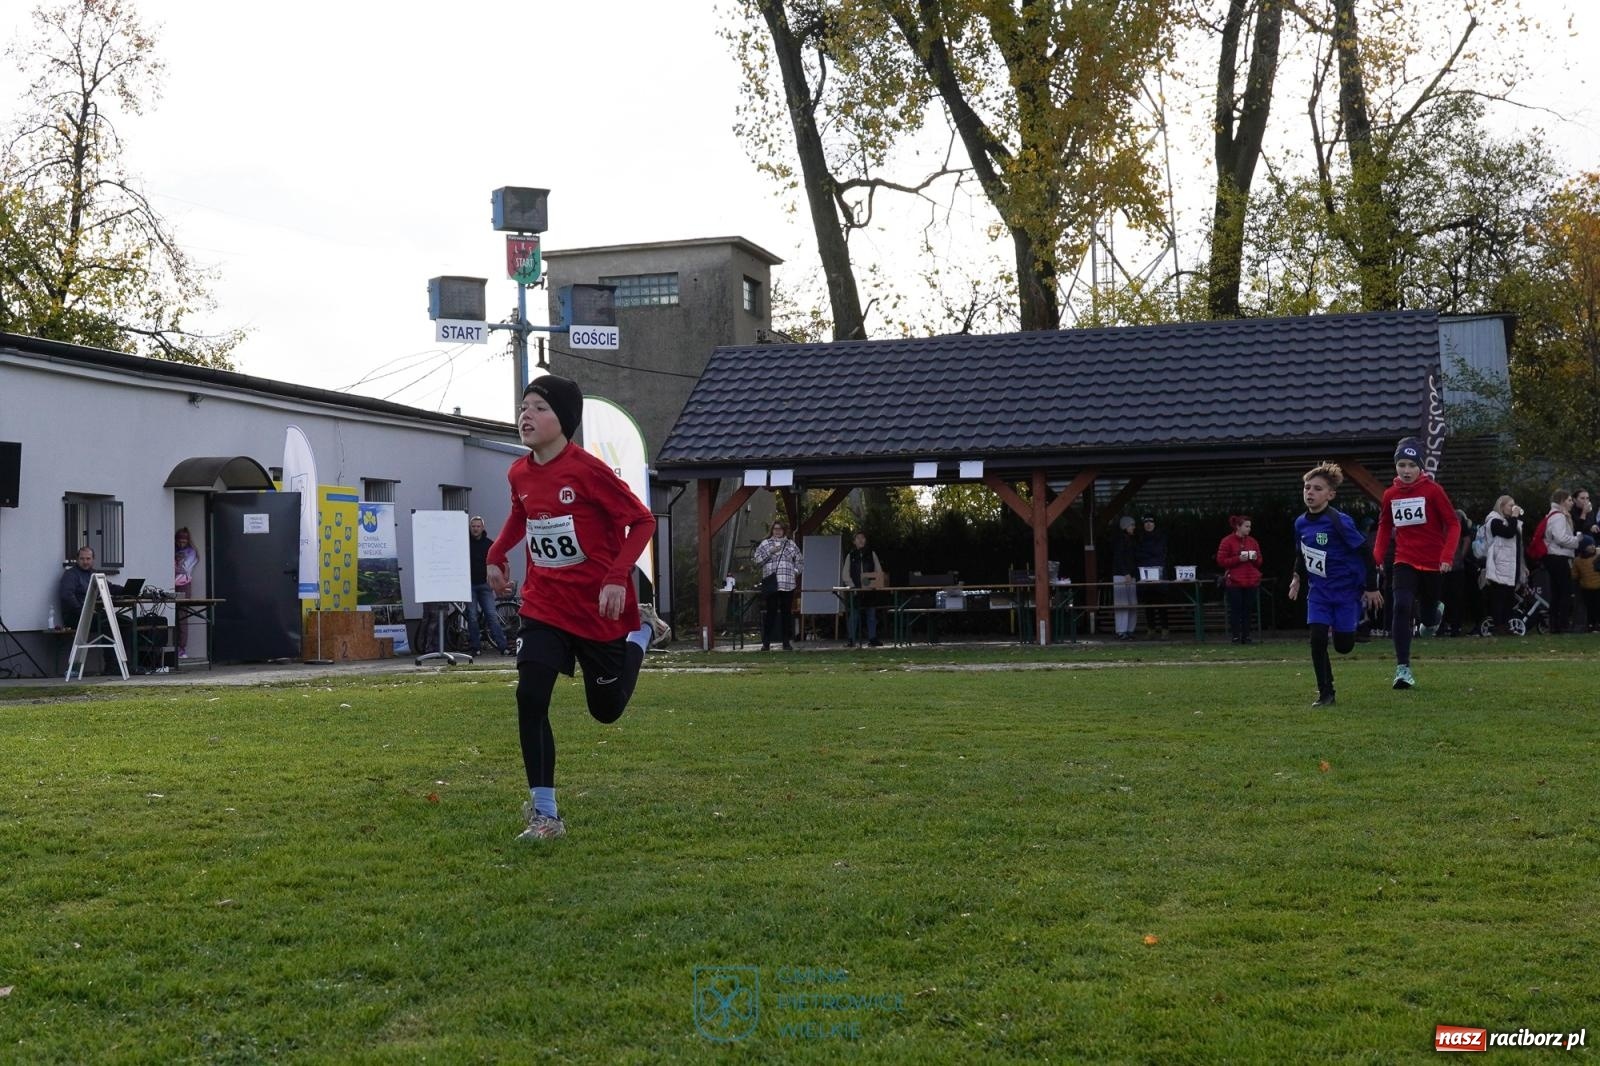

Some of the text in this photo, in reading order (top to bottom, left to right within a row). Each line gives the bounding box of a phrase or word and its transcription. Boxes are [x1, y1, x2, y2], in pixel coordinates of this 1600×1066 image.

[515, 257, 535, 268] START
[441, 325, 482, 340] START
[572, 329, 617, 346] GOŚCIE
[1394, 506, 1424, 521] 464
[530, 535, 578, 559] 468
[341, 640, 349, 659] 2
